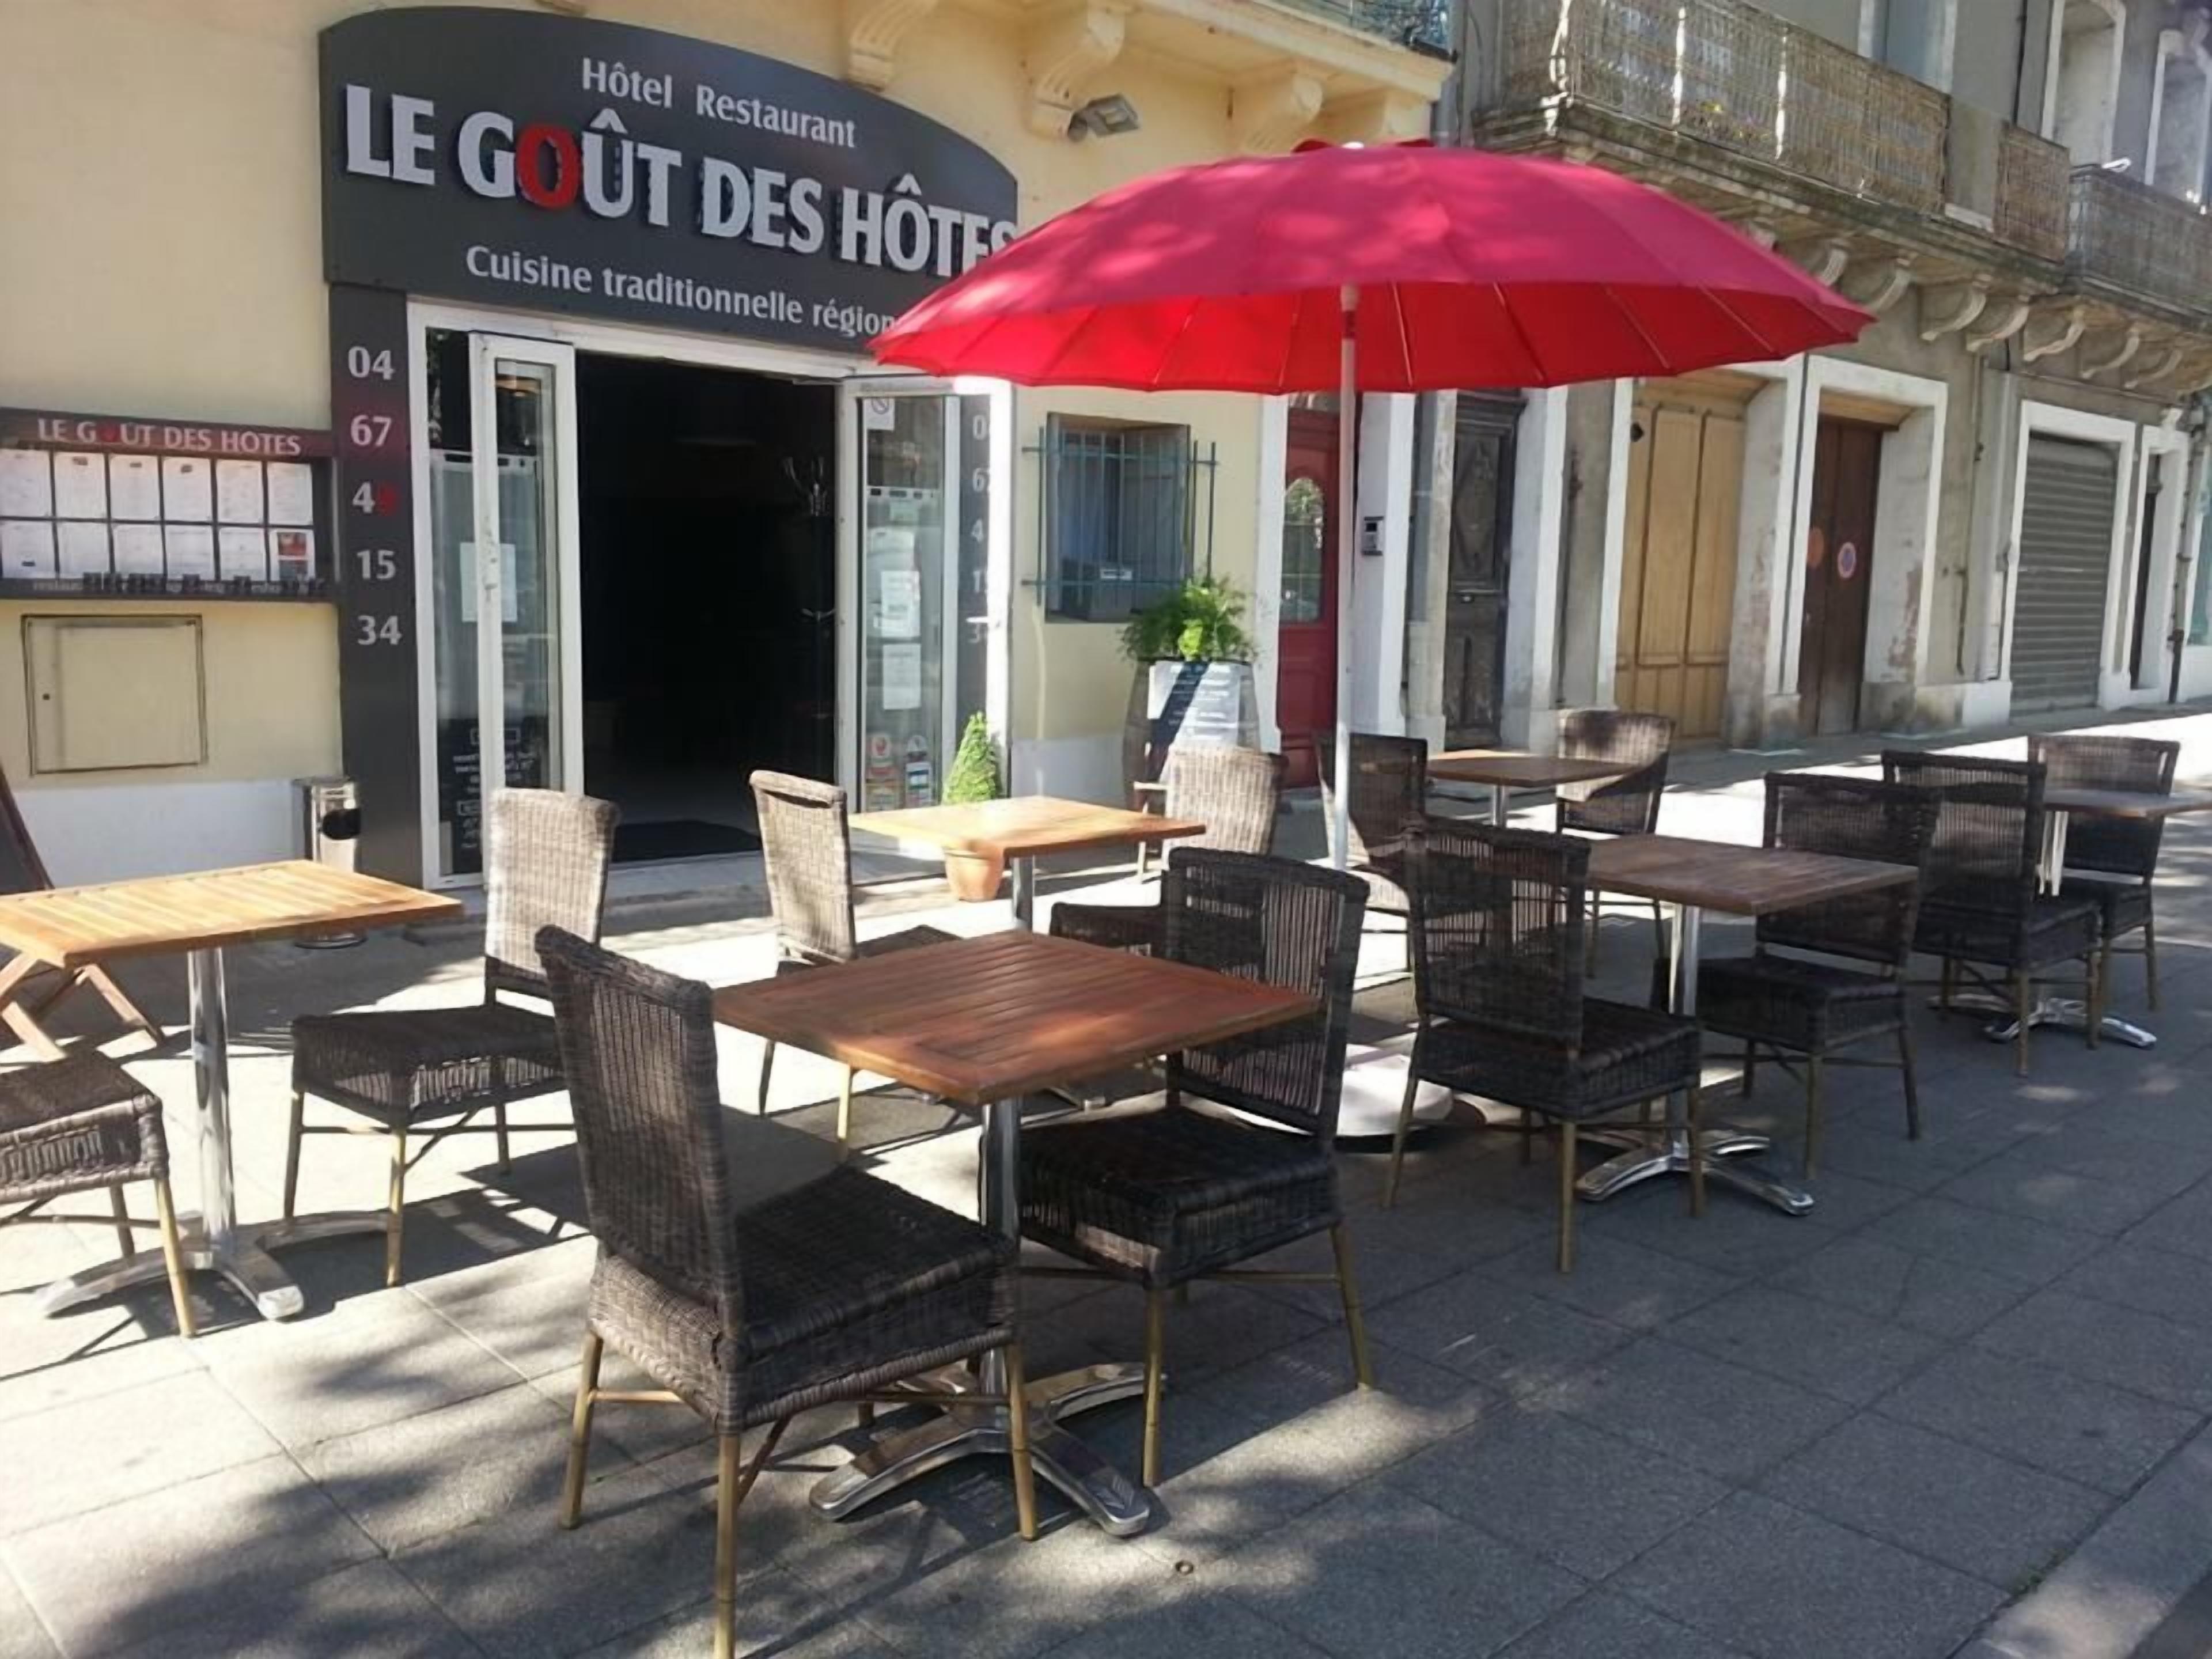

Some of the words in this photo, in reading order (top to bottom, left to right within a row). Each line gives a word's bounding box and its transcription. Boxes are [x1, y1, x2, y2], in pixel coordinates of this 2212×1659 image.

[583, 58, 672, 108] Hôtel
[696, 84, 856, 147] Restaurant
[347, 84, 435, 185] LE
[459, 108, 682, 226] GOÛT
[701, 156, 824, 253] DES
[466, 245, 592, 293] Cuisine
[603, 268, 803, 324] traditionnelle
[348, 346, 395, 380] 04
[37, 418, 66, 442] LE
[164, 426, 212, 452] DES
[350, 415, 392, 447] 67
[357, 550, 396, 580] 15
[357, 615, 402, 645] 34
